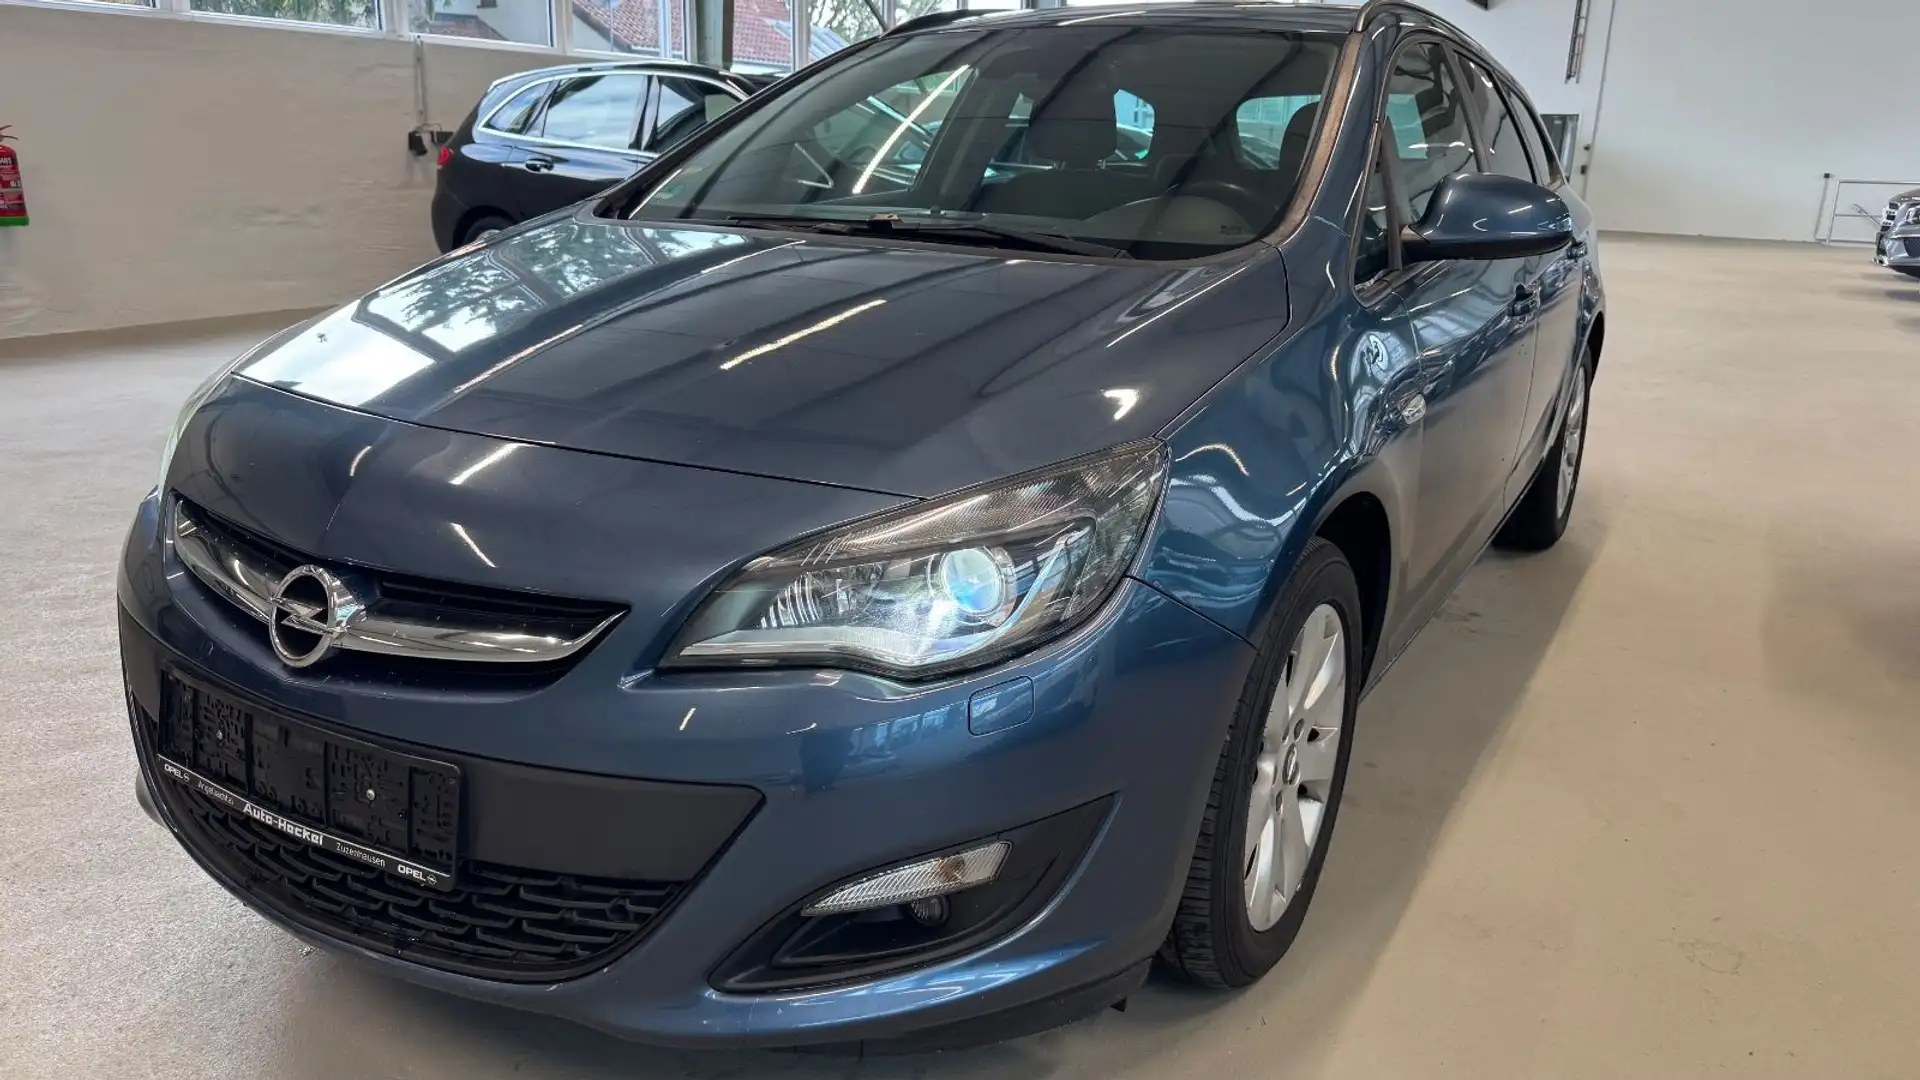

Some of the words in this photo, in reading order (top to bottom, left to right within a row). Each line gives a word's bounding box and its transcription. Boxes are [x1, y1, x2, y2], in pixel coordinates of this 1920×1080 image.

[164, 763, 184, 779] OPEL
[336, 842, 386, 868] Zuzenhausen
[397, 864, 426, 882] OPEL
